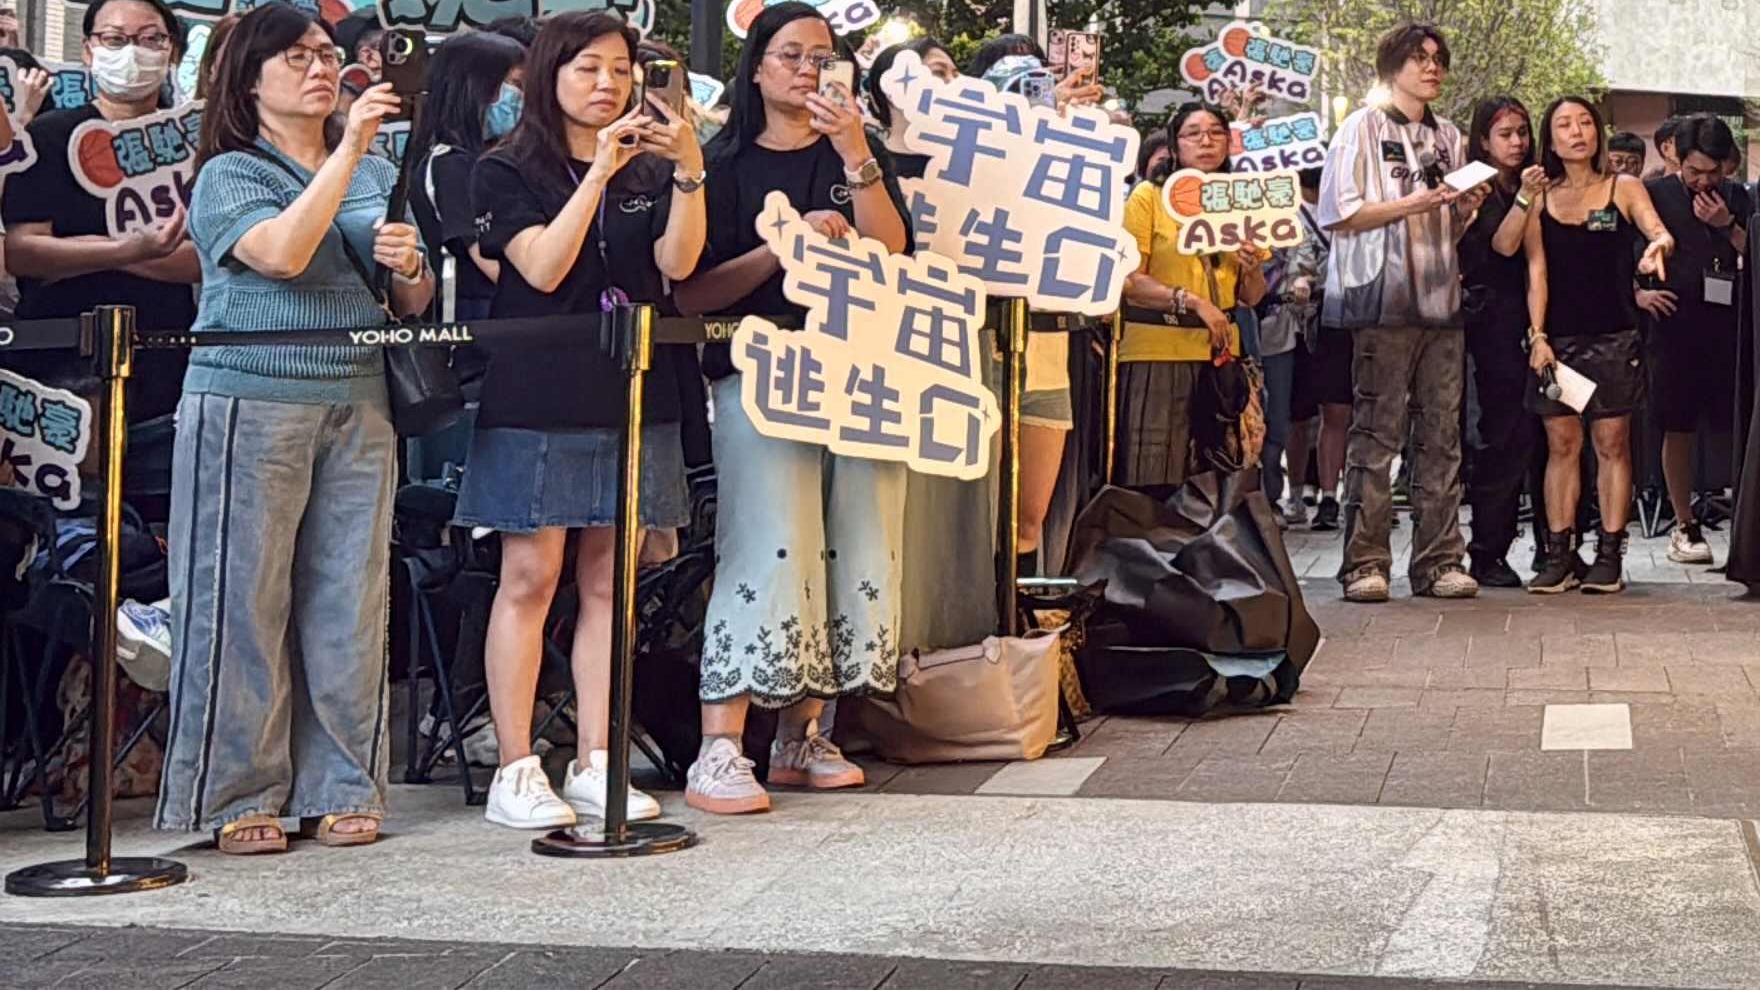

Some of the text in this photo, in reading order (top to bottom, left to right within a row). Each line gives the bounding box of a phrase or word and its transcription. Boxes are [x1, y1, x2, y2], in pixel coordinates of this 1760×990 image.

[917, 88, 1128, 221] 宇宙
[1235, 146, 1326, 174] Aska
[1201, 175, 1295, 214] 張馳豪
[1184, 216, 1298, 250] Aska
[792, 233, 977, 379] 宇宙
[349, 324, 473, 345] YOHO MALL
[745, 330, 982, 467] 逃生口
